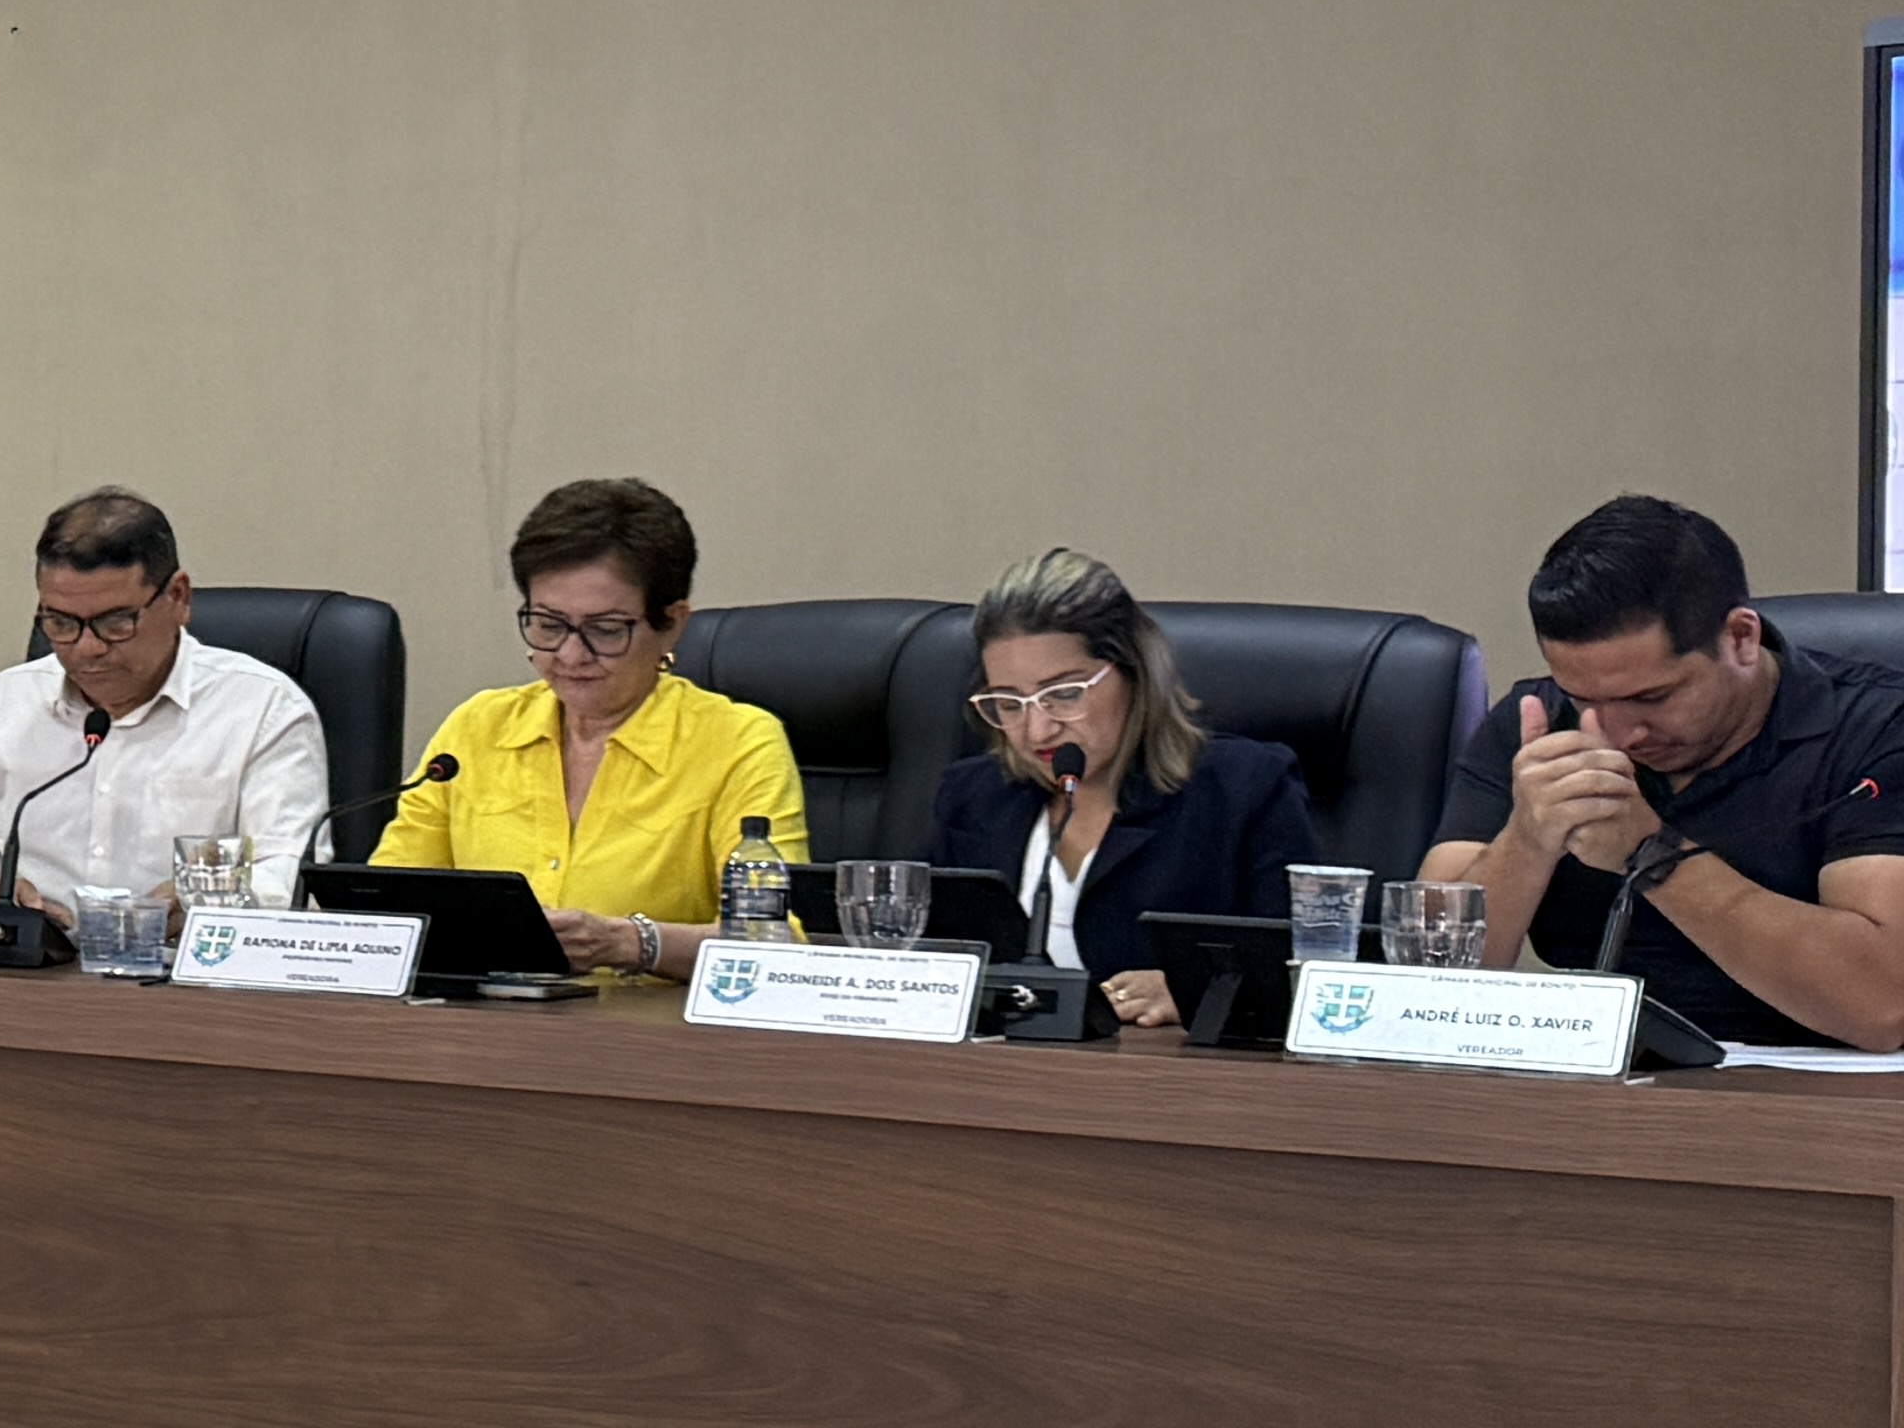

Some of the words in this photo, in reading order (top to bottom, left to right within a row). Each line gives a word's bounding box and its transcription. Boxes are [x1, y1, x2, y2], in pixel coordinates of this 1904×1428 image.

[300, 939, 315, 951] DE
[767, 972, 842, 988] ROSINEIDE
[865, 979, 896, 991] DOS
[900, 980, 960, 995] SANTOS
[1400, 1007, 1459, 1023] ANDRÉ
[1465, 1012, 1502, 1026] LUIZ
[1531, 1016, 1593, 1032] XAVIER
